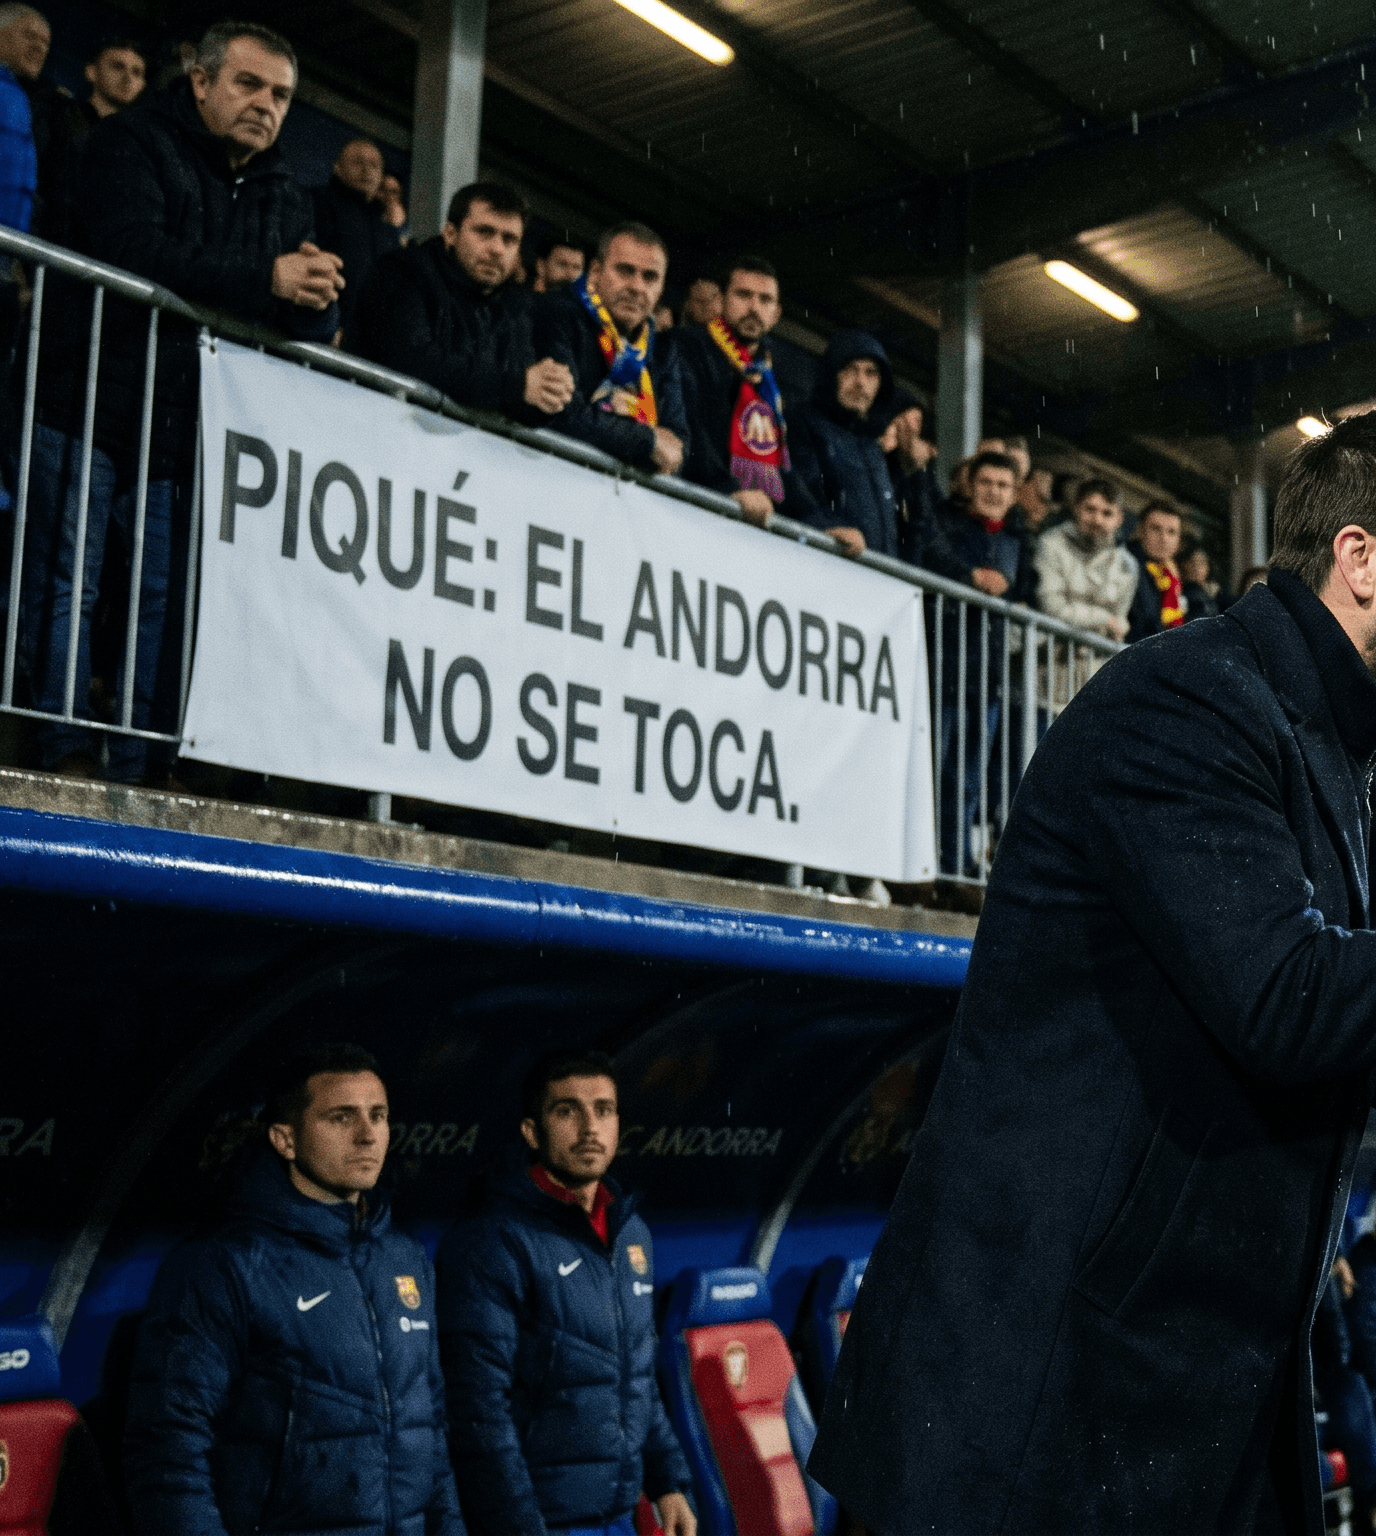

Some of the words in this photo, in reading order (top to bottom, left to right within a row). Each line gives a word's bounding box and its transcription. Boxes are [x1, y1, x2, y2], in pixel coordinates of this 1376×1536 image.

[219, 429, 498, 613] PIQUÉ:
[525, 524, 603, 642] EL
[623, 560, 900, 722] ANDORRA
[383, 638, 492, 762] NO
[516, 671, 601, 786] SE
[623, 695, 800, 824] TOCA.
[638, 1125, 785, 1157] ANDORRA
